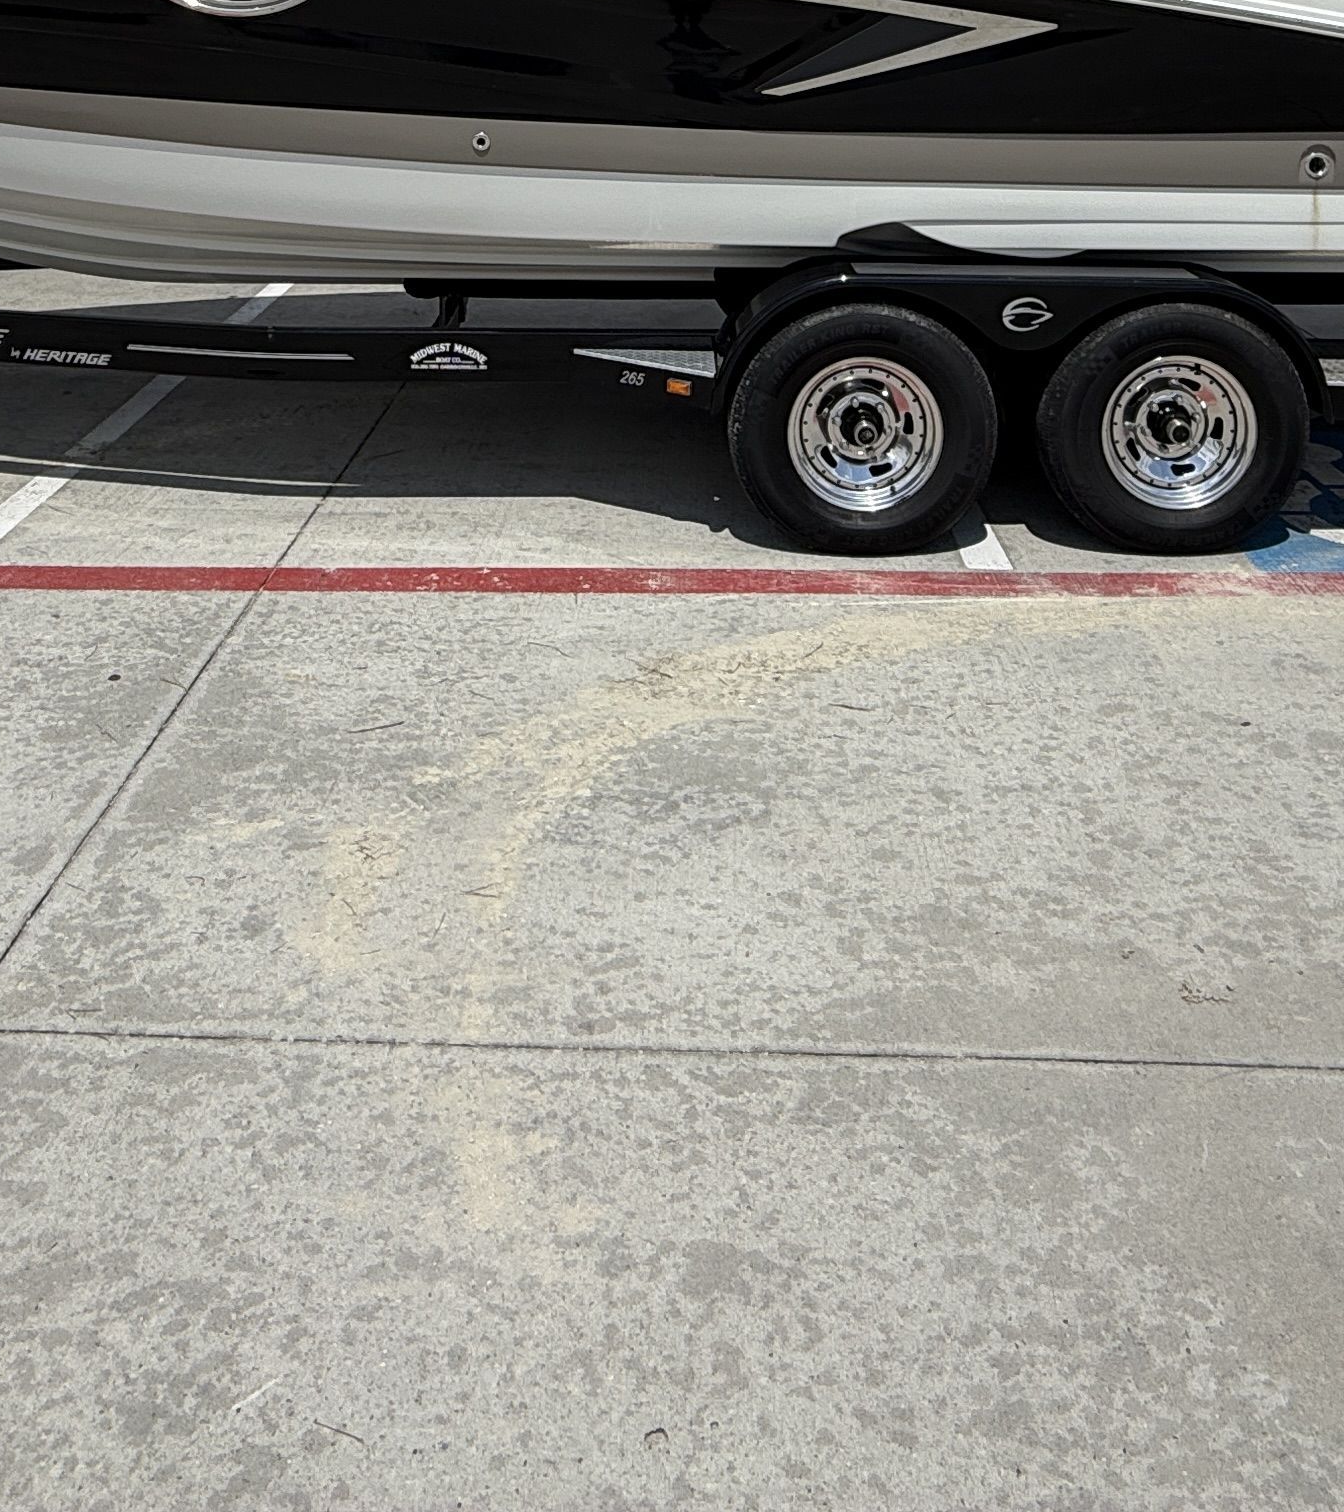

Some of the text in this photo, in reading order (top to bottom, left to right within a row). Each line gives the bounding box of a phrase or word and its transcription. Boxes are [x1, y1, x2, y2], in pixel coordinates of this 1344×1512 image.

[22, 347, 112, 366] HERITAGE
[409, 343, 488, 365] MIDWEST MARINE
[619, 370, 646, 386] 265
